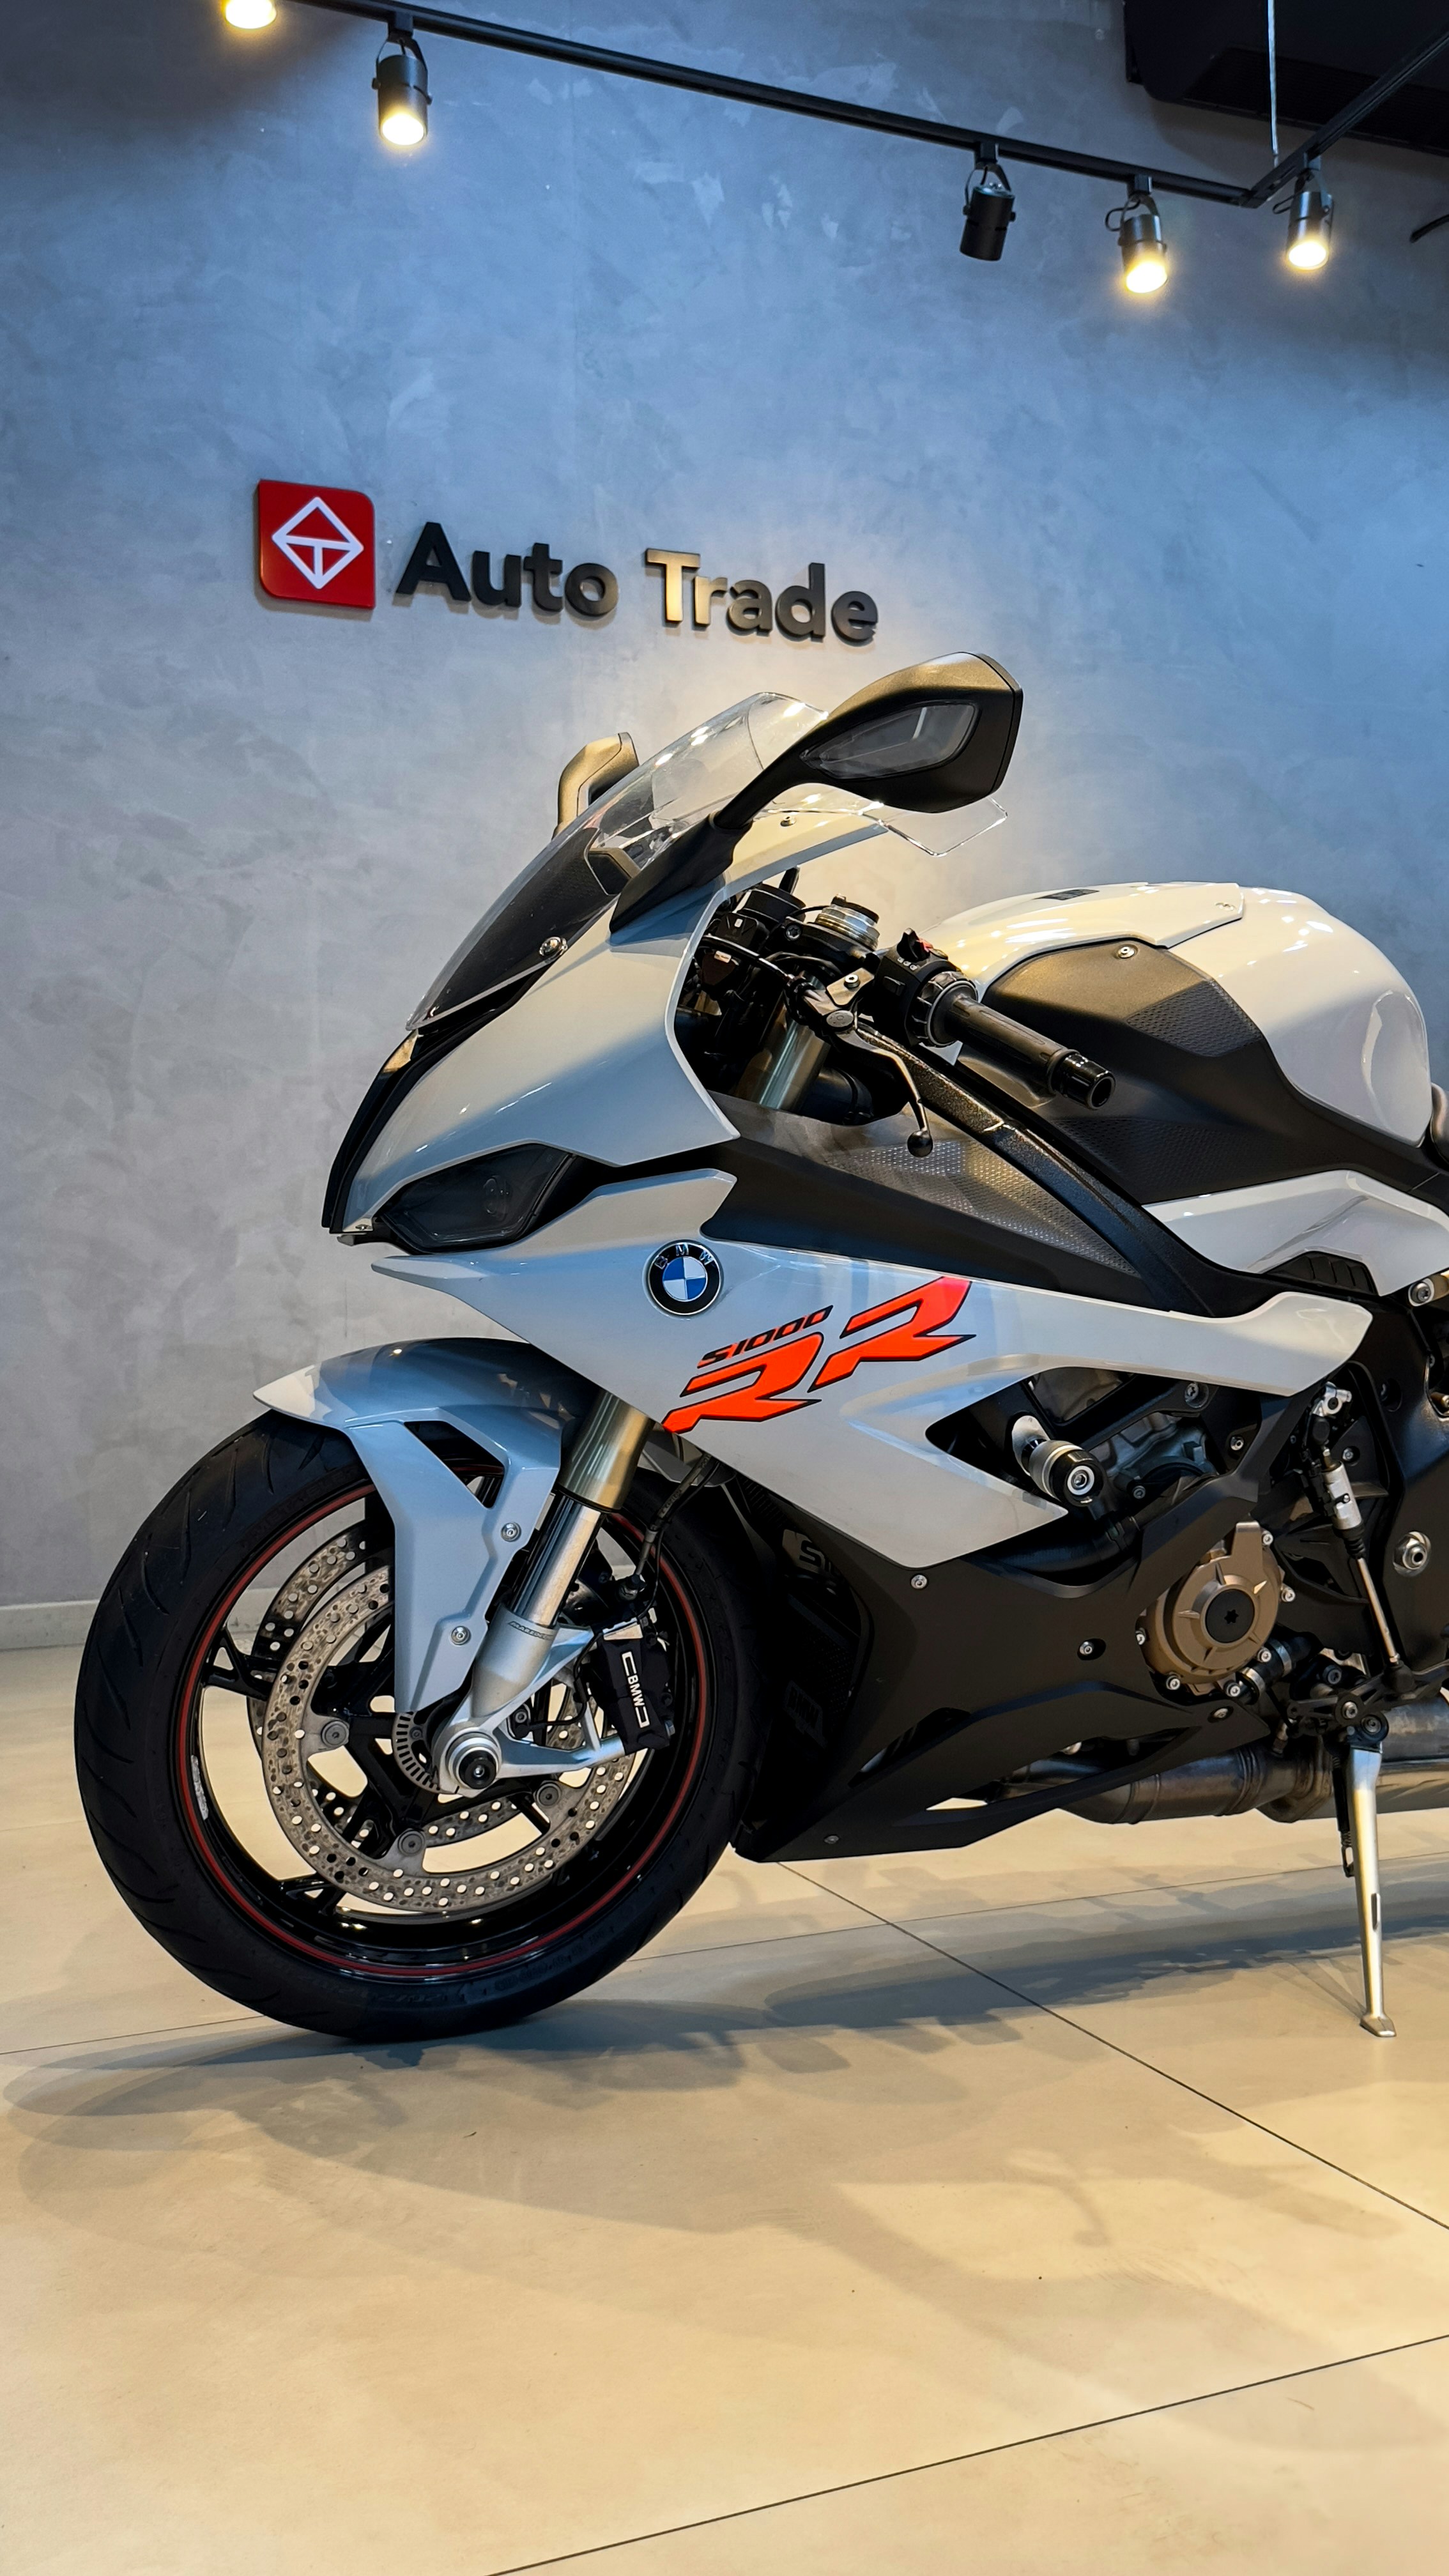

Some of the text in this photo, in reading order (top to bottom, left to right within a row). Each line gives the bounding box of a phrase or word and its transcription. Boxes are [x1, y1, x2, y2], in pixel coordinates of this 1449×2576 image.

[394, 521, 879, 643] Auto Trade
[654, 1242, 715, 1269] BMW
[662, 1276, 977, 1434] RR
[696, 1305, 834, 1368] S1000
[627, 1675, 645, 1707] BMW
